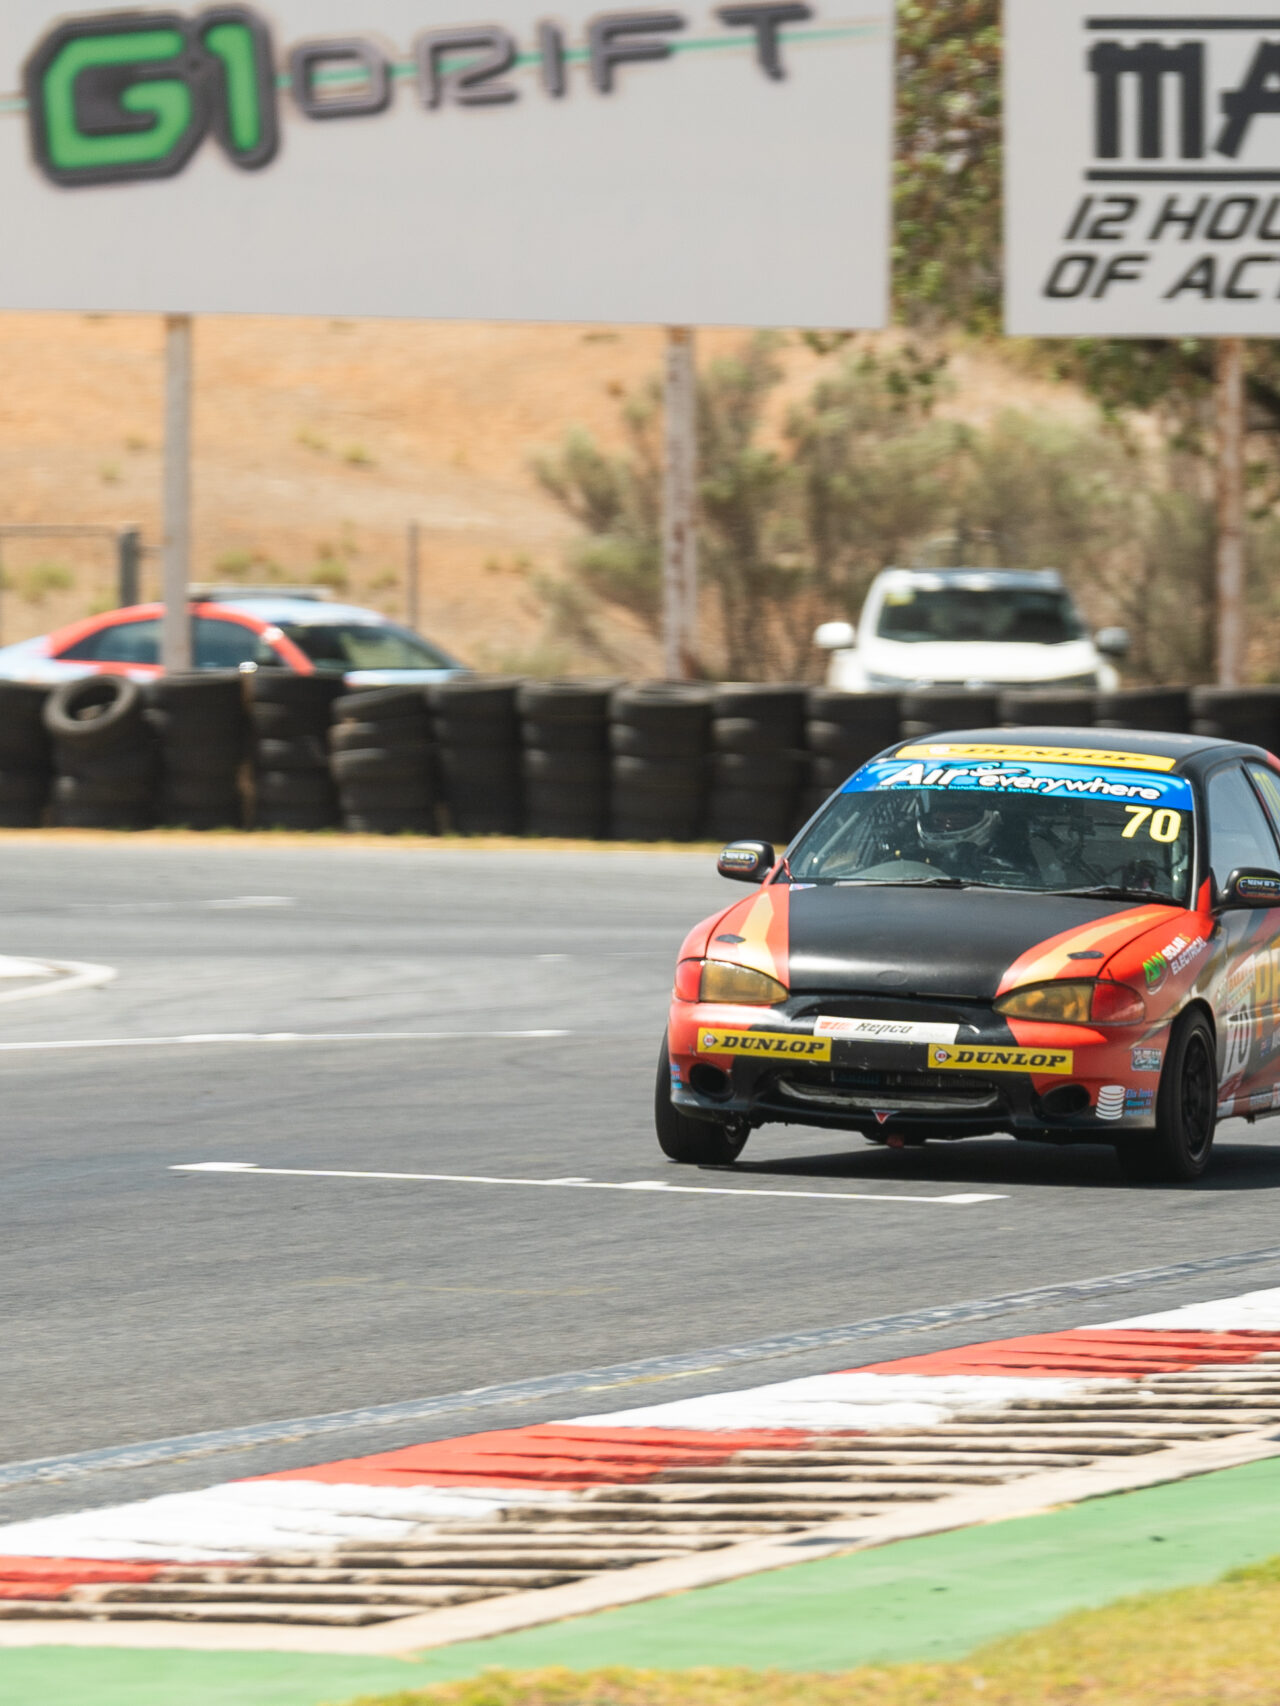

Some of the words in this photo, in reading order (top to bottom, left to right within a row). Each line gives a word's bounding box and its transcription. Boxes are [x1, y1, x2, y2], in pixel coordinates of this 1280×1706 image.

[291, 3, 818, 119] DRIFT
[1063, 195, 1132, 242] 12
[1041, 254, 1150, 301] OF
[880, 763, 965, 787] Air
[978, 769, 1162, 801] everywhere
[1121, 805, 1182, 843] 70
[721, 1035, 825, 1054] DUNLOP
[855, 1022, 914, 1035] Repco
[955, 1051, 1066, 1067] DUNLOP
